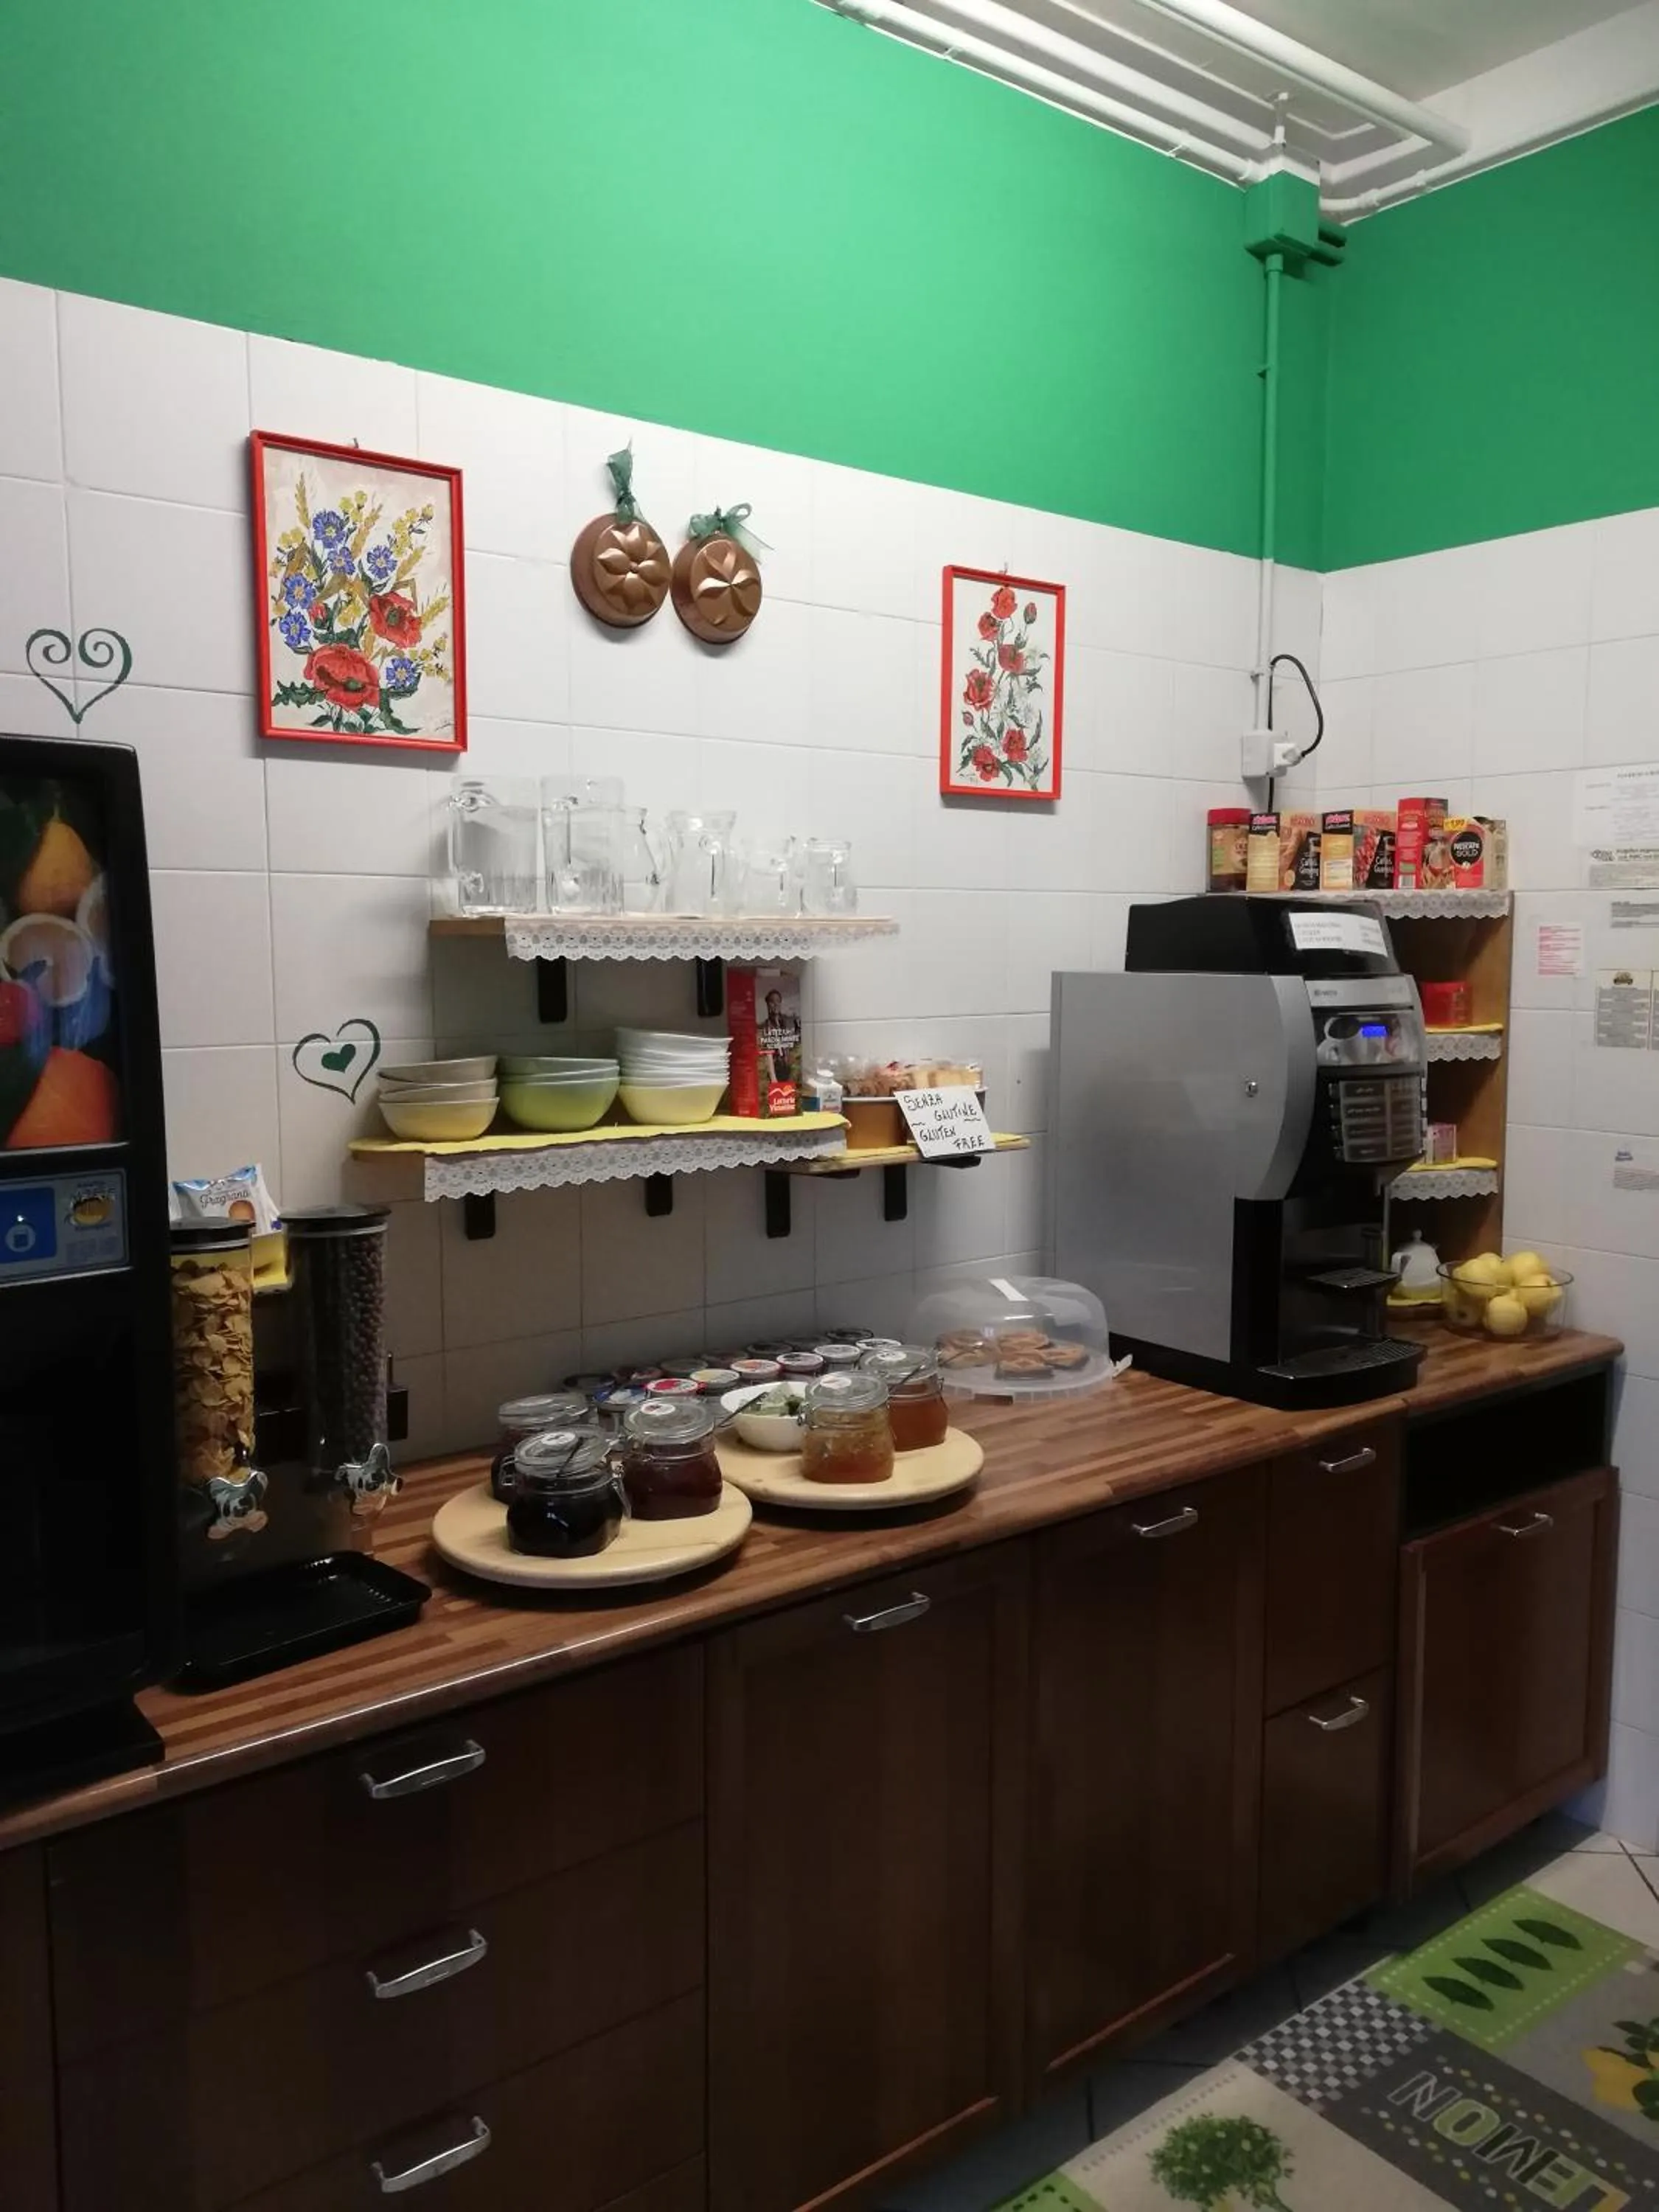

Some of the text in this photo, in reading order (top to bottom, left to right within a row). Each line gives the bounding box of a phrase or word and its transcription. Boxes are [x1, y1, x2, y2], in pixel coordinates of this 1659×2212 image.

[1456, 849, 1478, 858] GOLD
[903, 1093, 943, 1111] SENZA
[933, 1102, 977, 1121] GLUTINE
[919, 1124, 956, 1141] GLUTEN
[951, 1135, 985, 1150] FREE
